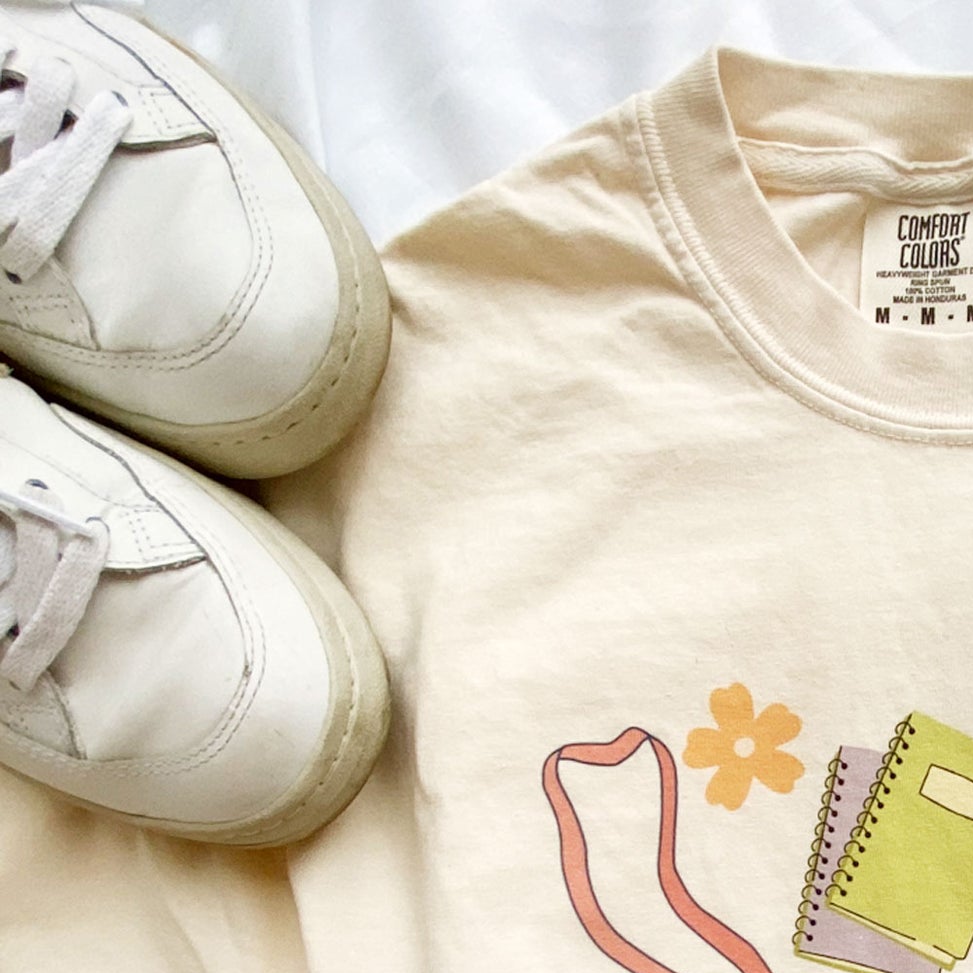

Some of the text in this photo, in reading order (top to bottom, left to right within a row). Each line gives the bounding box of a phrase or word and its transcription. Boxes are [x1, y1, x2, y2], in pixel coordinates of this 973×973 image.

[898, 212, 970, 241] COMFORT
[932, 267, 968, 277] GARMENT
[930, 278, 951, 286] SPUN
[925, 286, 956, 294] COTTON
[893, 294, 967, 304] MADE IN HONDURAS
[876, 307, 890, 323] M
[921, 307, 935, 325] M
